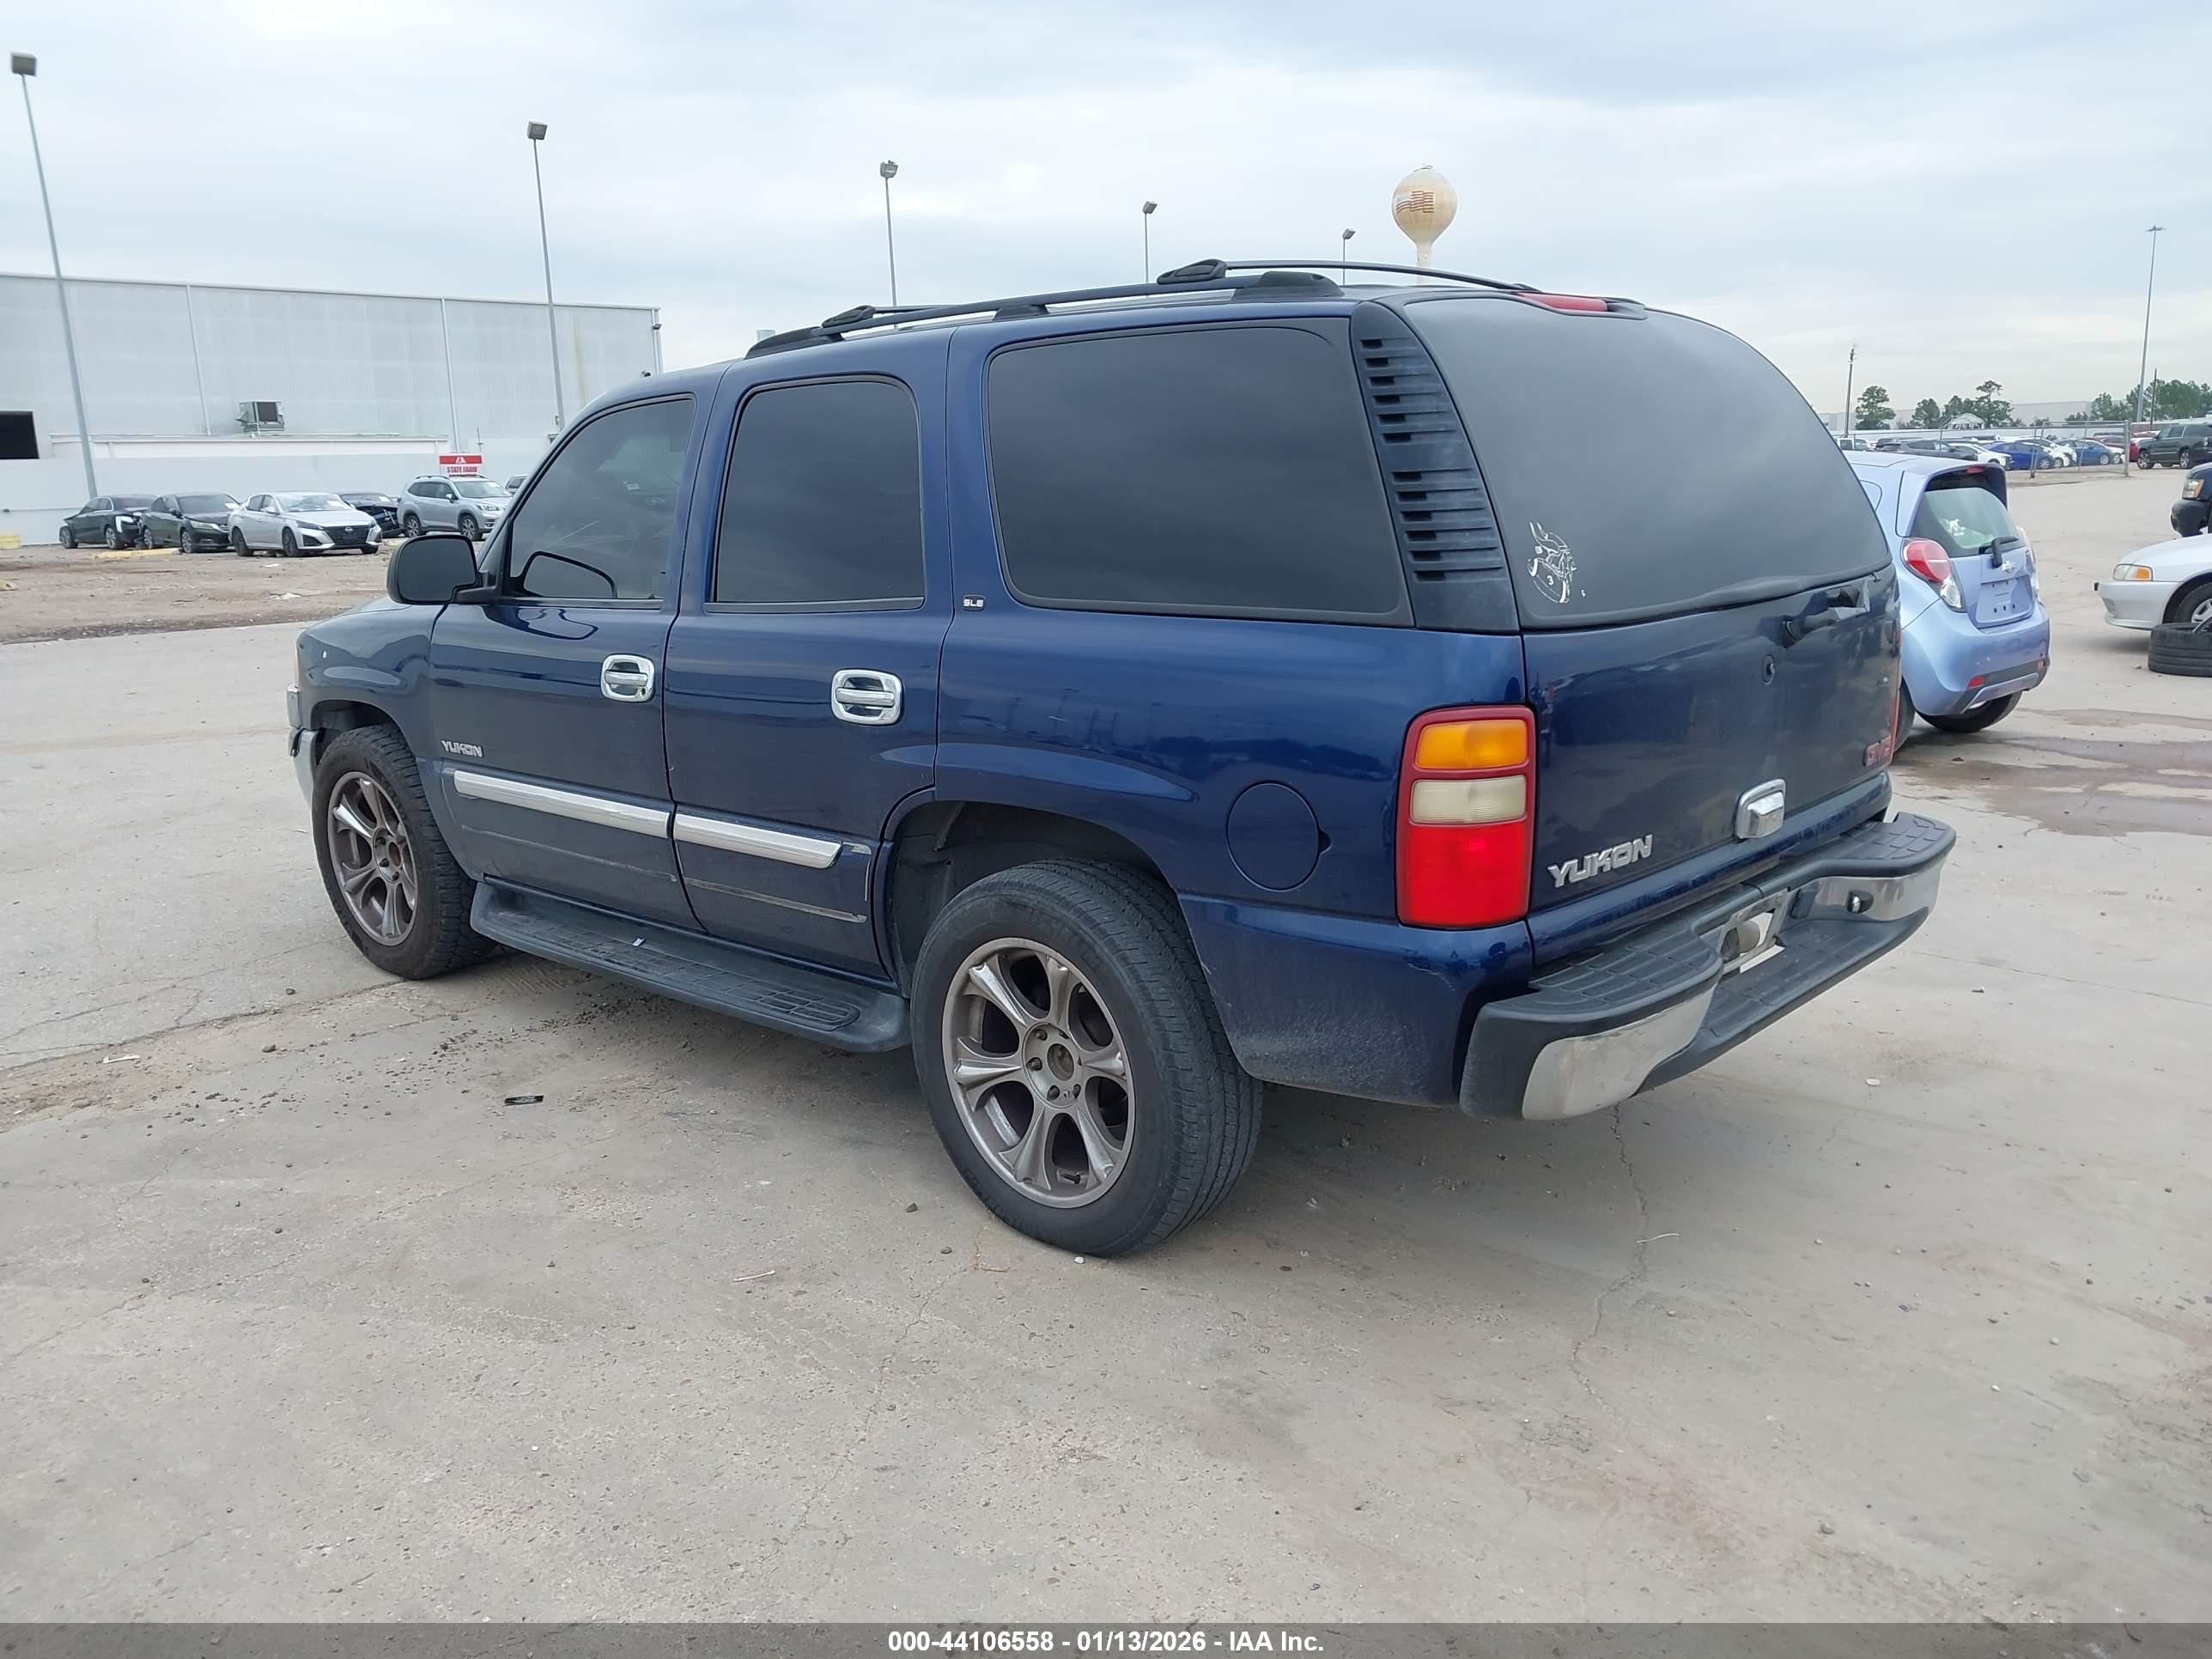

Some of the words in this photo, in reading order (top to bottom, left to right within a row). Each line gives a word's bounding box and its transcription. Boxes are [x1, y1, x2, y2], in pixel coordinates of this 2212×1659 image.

[1547, 574, 1554, 586] 3
[963, 599, 984, 607] SLE
[441, 740, 483, 757] YUKON
[1547, 834, 1653, 888] YUKON
